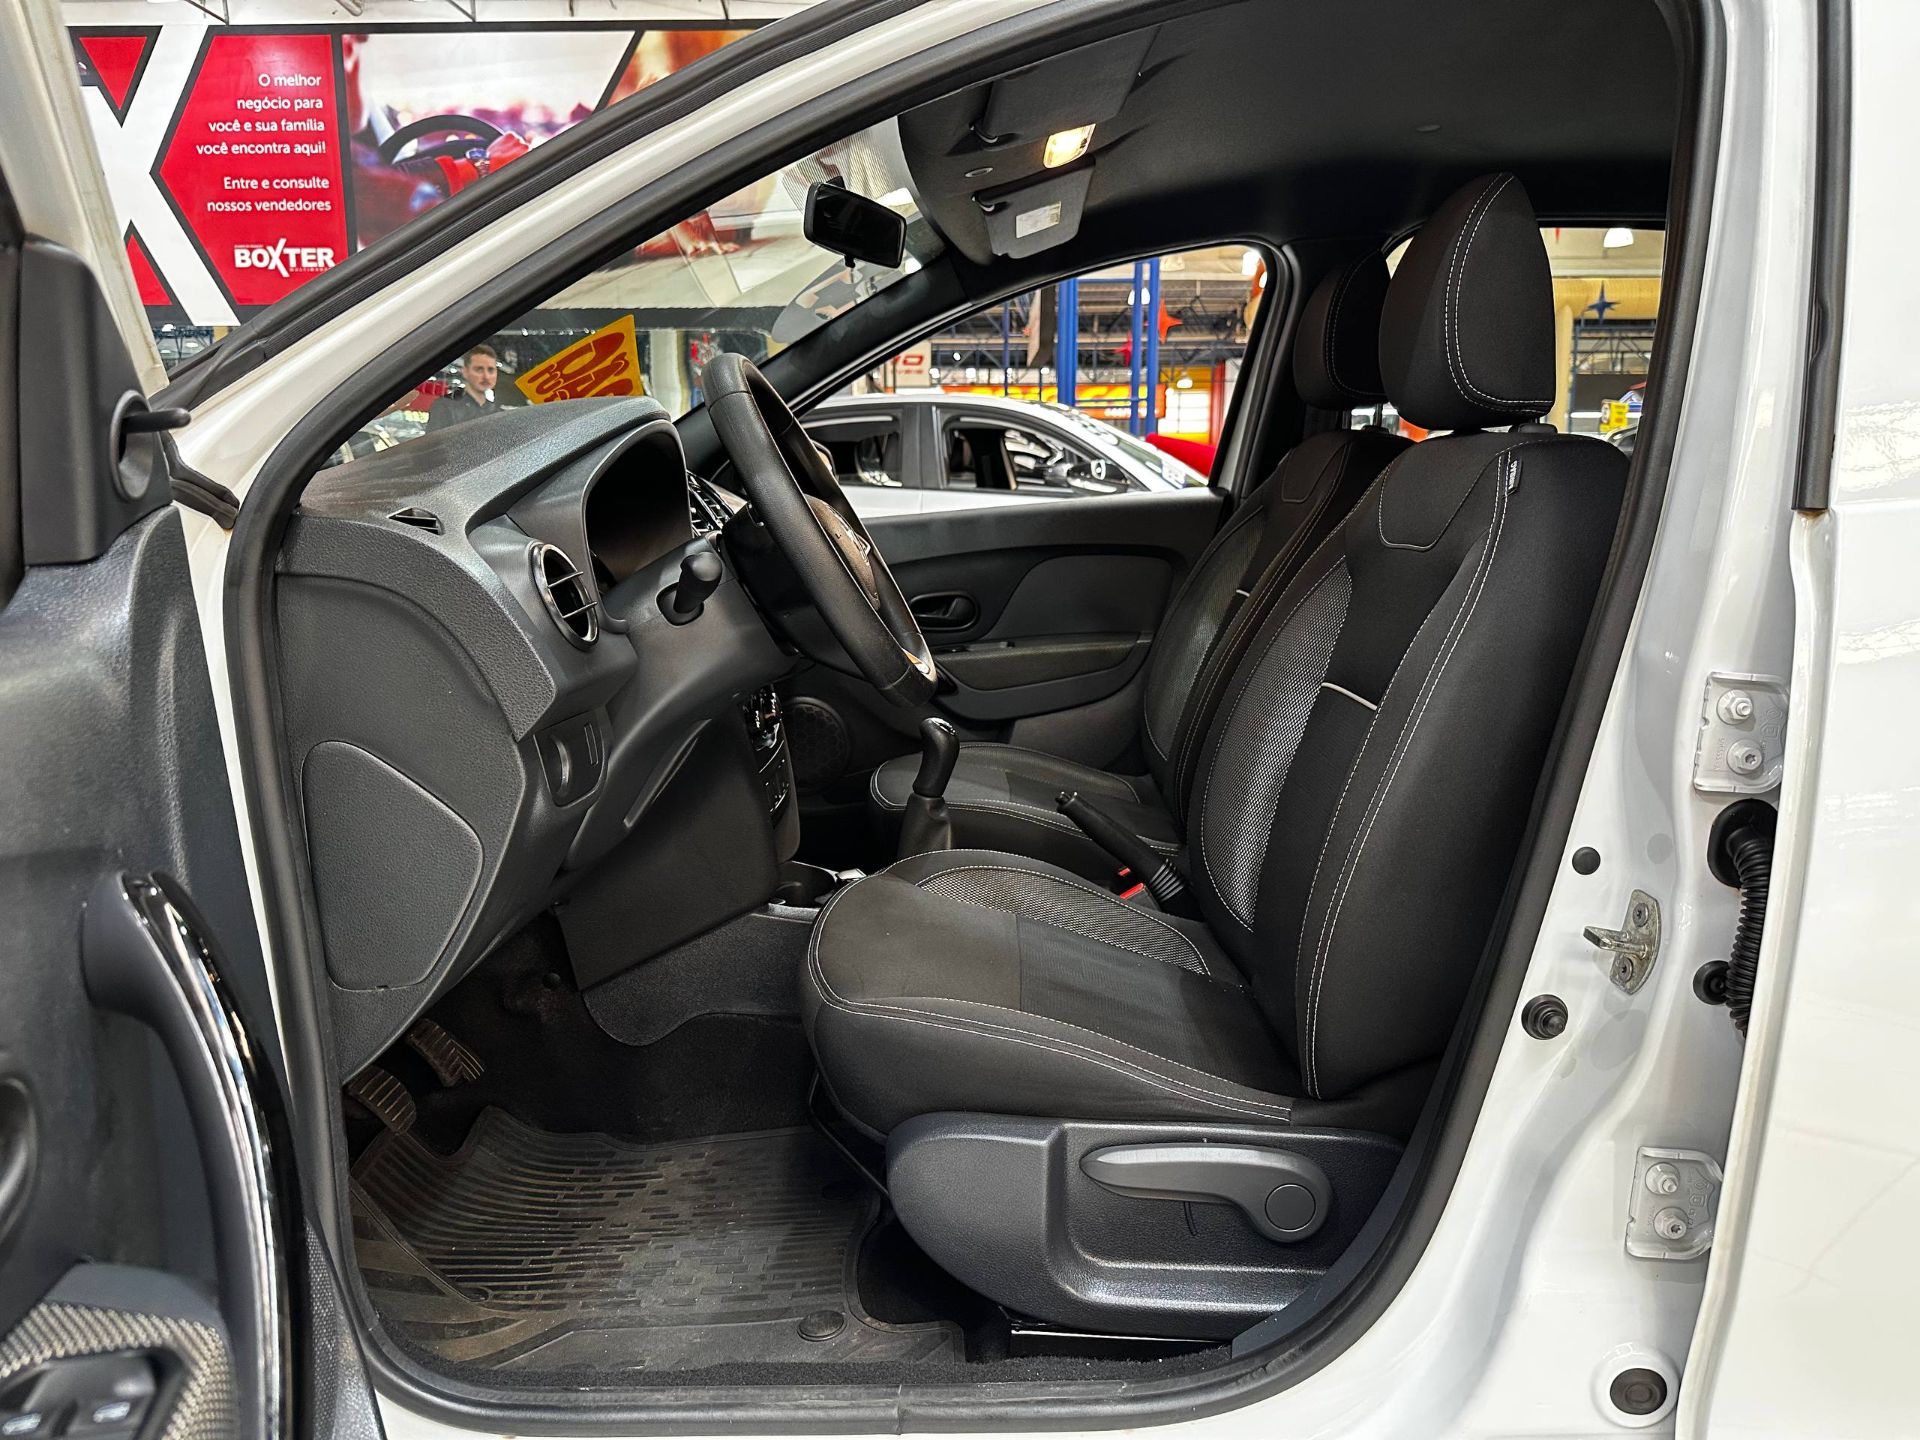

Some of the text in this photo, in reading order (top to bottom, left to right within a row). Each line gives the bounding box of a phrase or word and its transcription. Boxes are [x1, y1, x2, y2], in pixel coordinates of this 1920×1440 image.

[259, 74, 321, 87] O melhor
[237, 96, 323, 112] negócio para
[208, 119, 325, 132] você e sua família
[196, 141, 326, 156] você encontra aqui!
[223, 176, 329, 189] Entre e consulte
[207, 198, 331, 211] nossos vendedores
[234, 238, 336, 278] BOXTER
